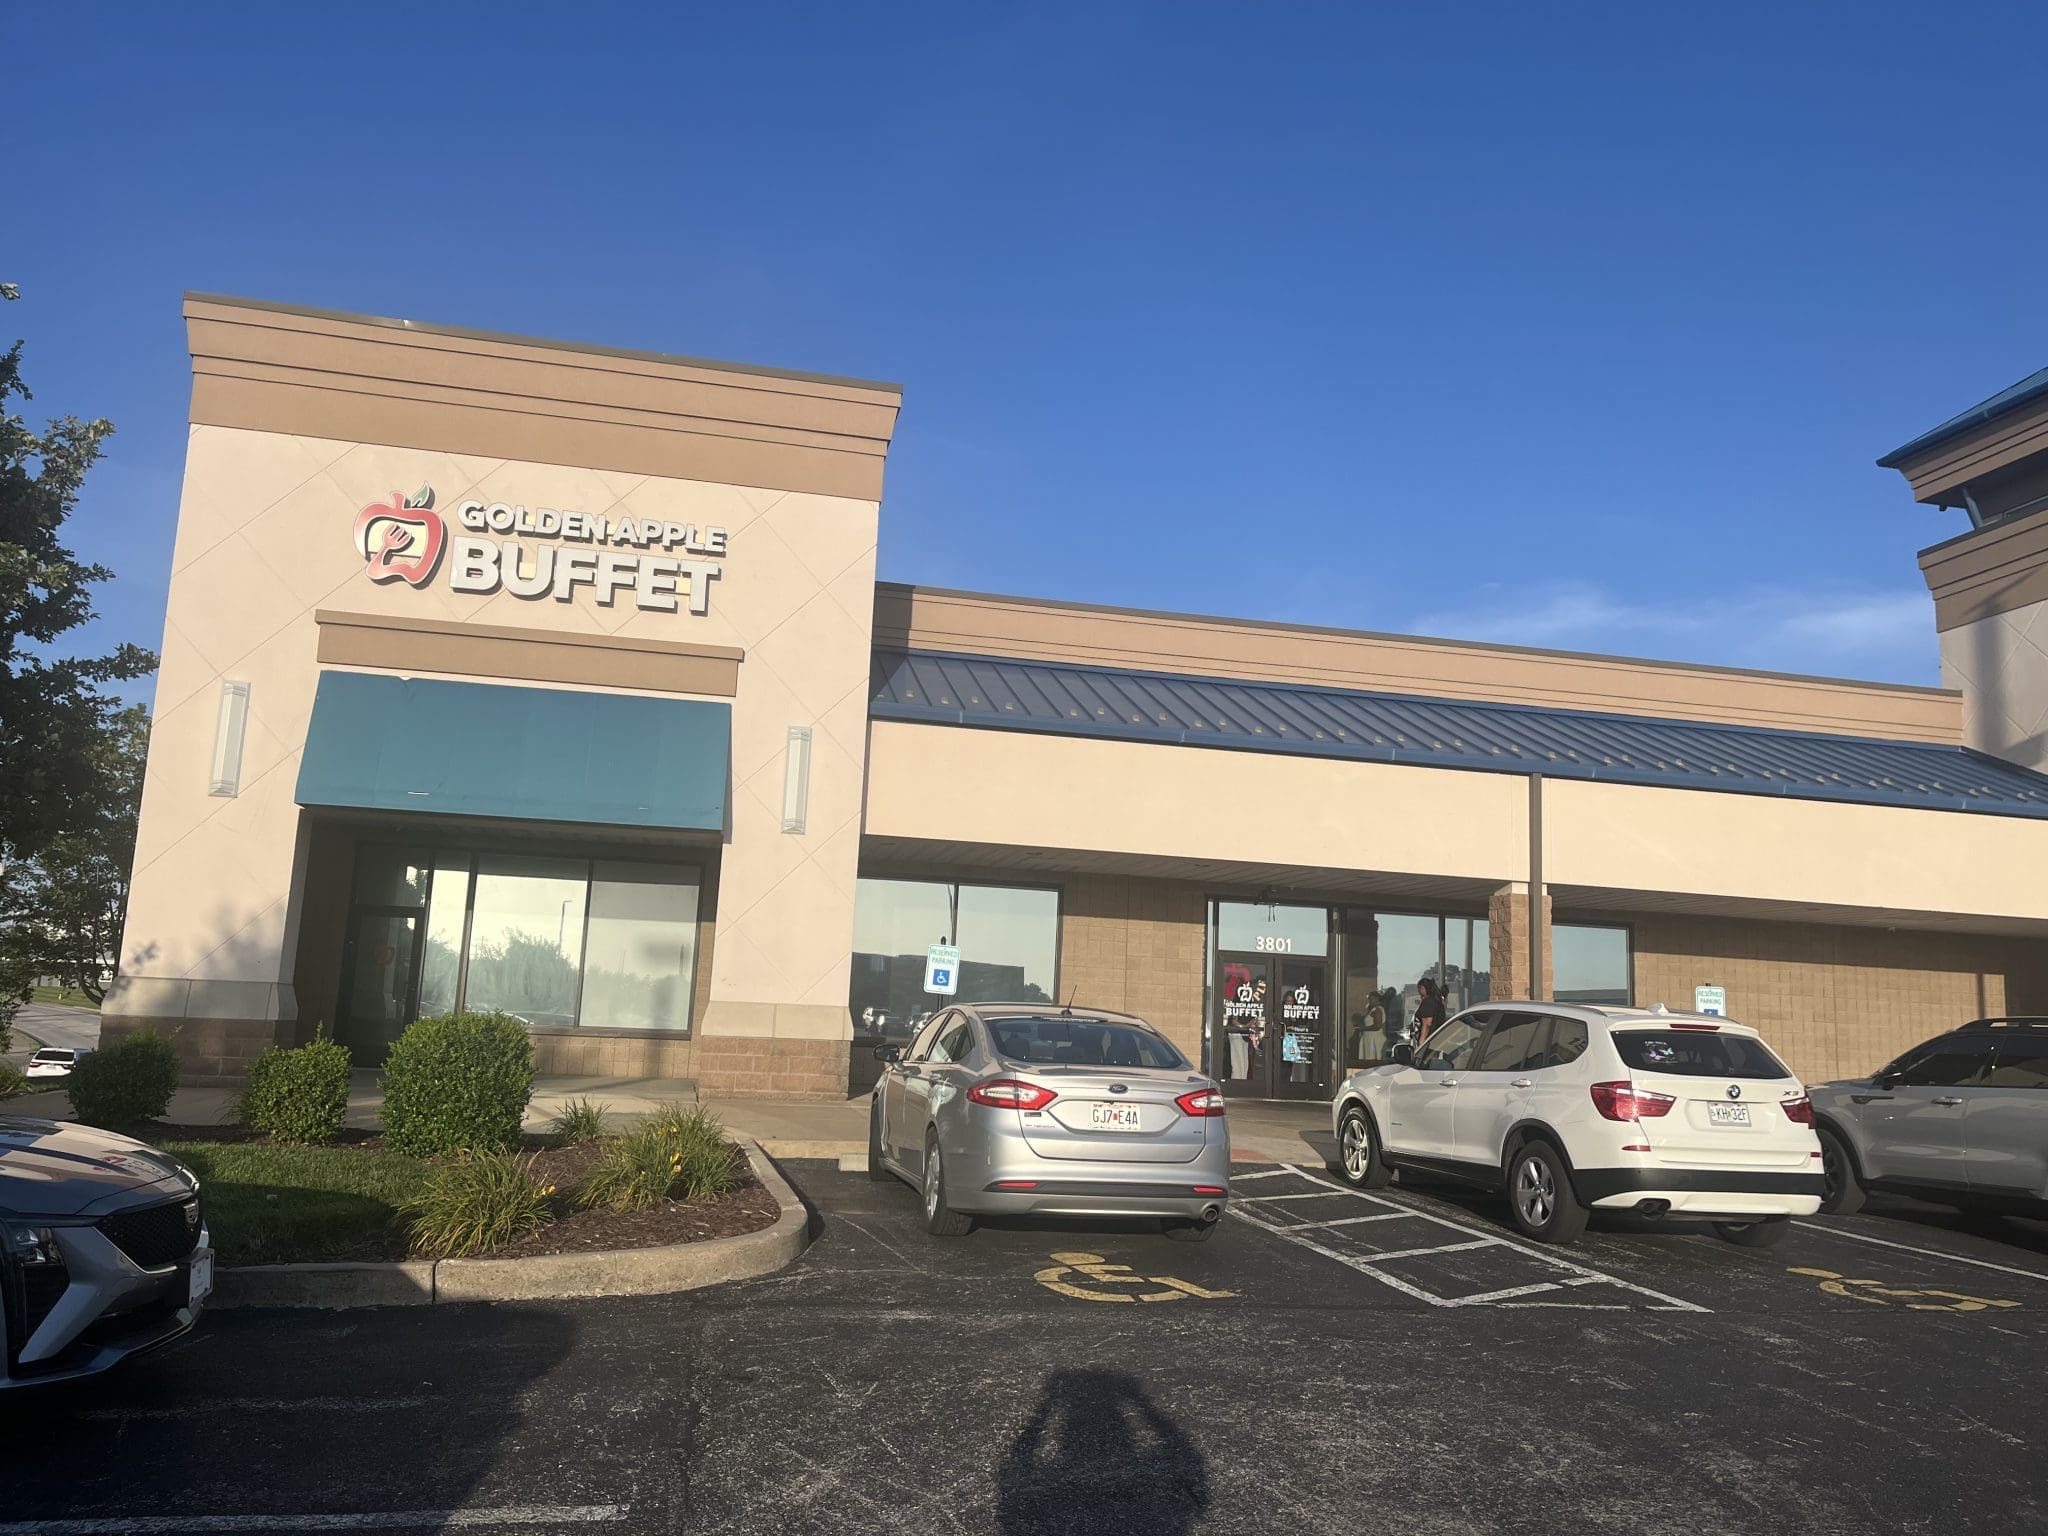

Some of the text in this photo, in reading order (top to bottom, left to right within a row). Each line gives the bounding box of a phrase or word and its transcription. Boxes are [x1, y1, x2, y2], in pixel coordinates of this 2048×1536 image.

[457, 499, 727, 553] GOLDEN APPLE
[450, 535, 722, 616] BUFFET
[1256, 936, 1291, 952] 3801
[930, 948, 959, 957] RESERVED
[931, 957, 956, 965] PARKING
[1226, 1008, 1264, 1018] BUFFET
[1284, 1010, 1320, 1019] BUFFET
[1092, 1109, 1138, 1124] GJ7 E4A
